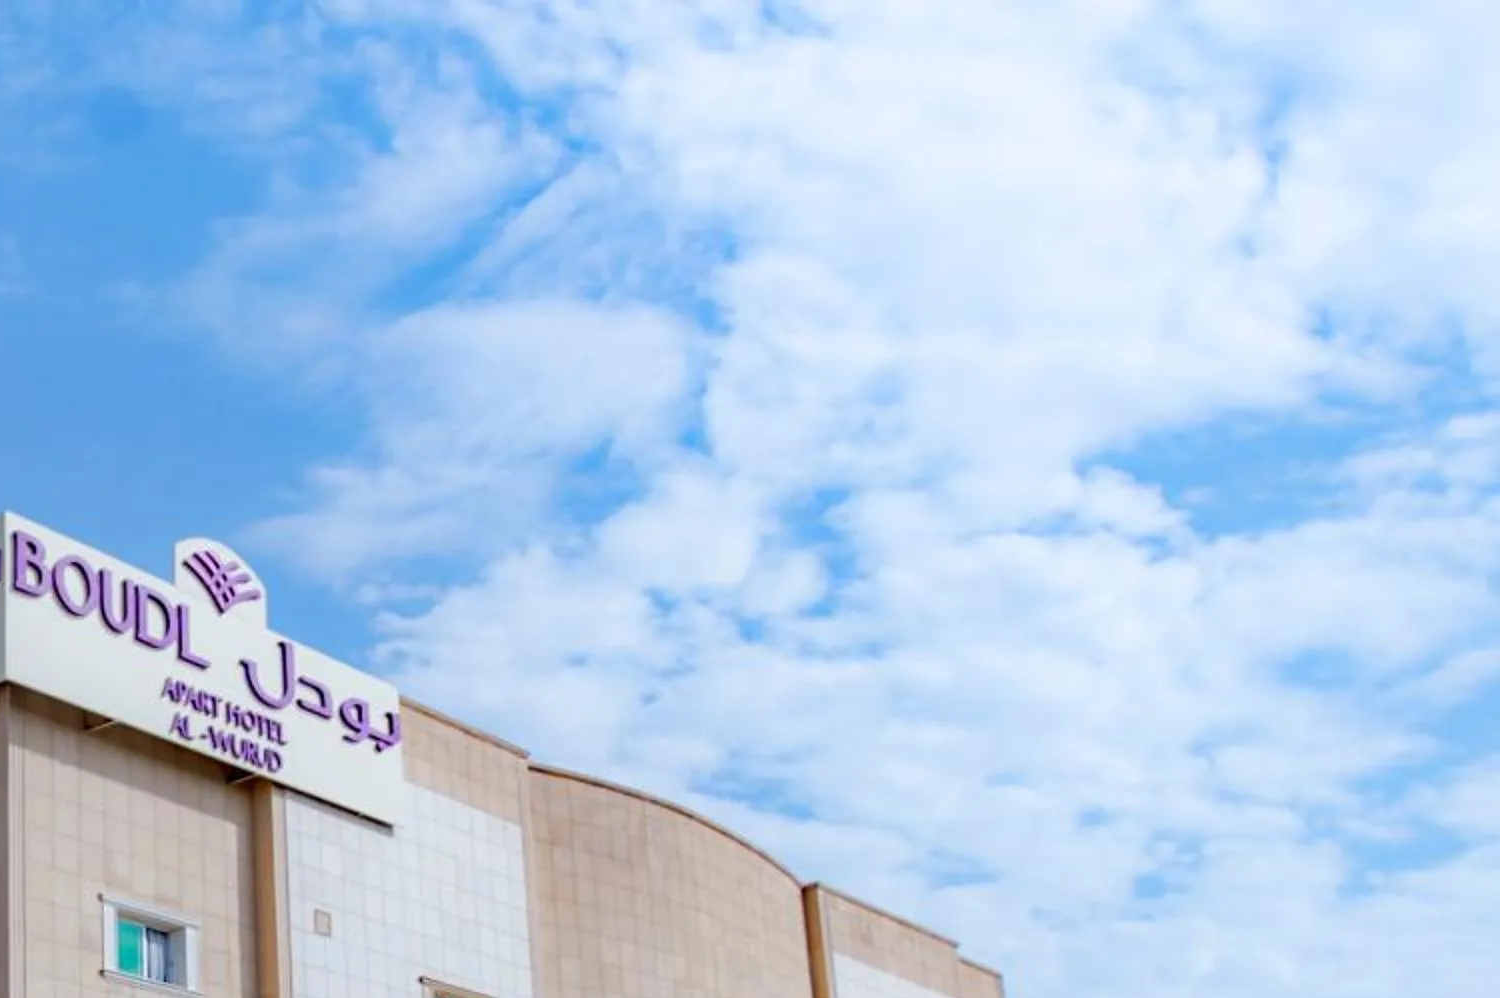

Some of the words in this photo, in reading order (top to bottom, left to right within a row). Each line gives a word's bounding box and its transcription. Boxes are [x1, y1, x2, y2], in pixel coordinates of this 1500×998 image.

[11, 530, 211, 671] BOUDL
[160, 677, 222, 719] APART
[224, 700, 287, 747] HOTEL
[237, 640, 400, 753] بودل
